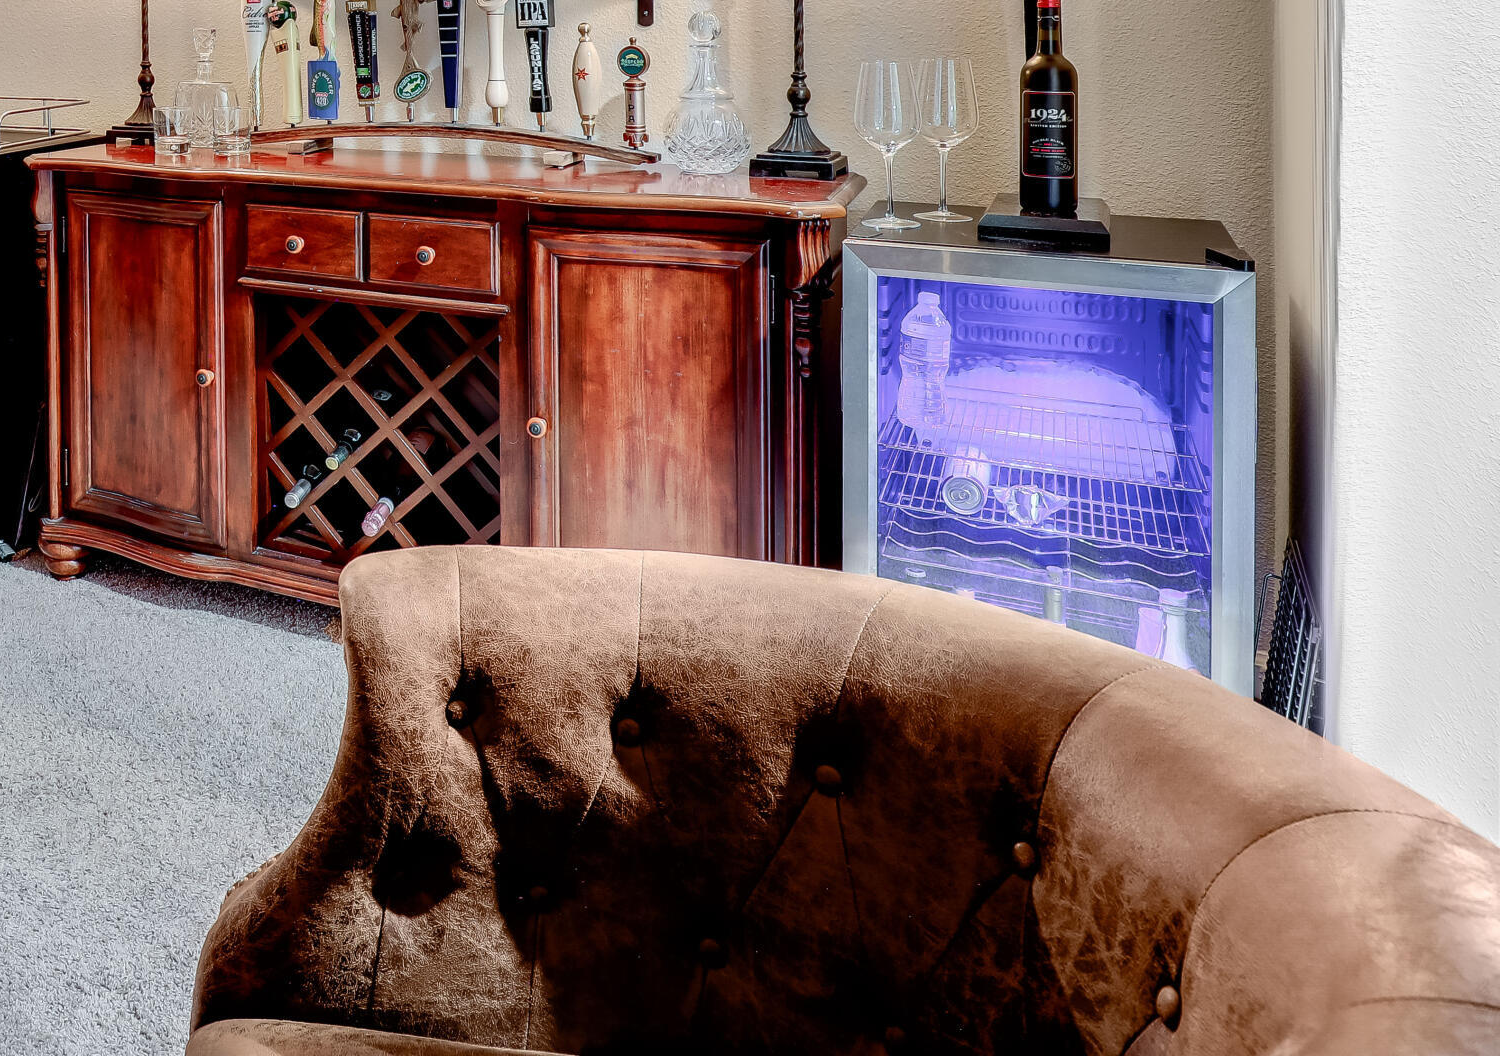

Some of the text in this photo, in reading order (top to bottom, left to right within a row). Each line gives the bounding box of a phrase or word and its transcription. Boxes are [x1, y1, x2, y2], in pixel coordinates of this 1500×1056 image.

[518, 1, 548, 21] IPA
[355, 14, 365, 66] HOPSECUTIONER
[529, 37, 543, 91] LAGUNITAS
[310, 71, 334, 95] SWEETWATER
[316, 96, 327, 105] 420
[627, 93, 636, 123] IPA
[1030, 108, 1067, 122] 1924
